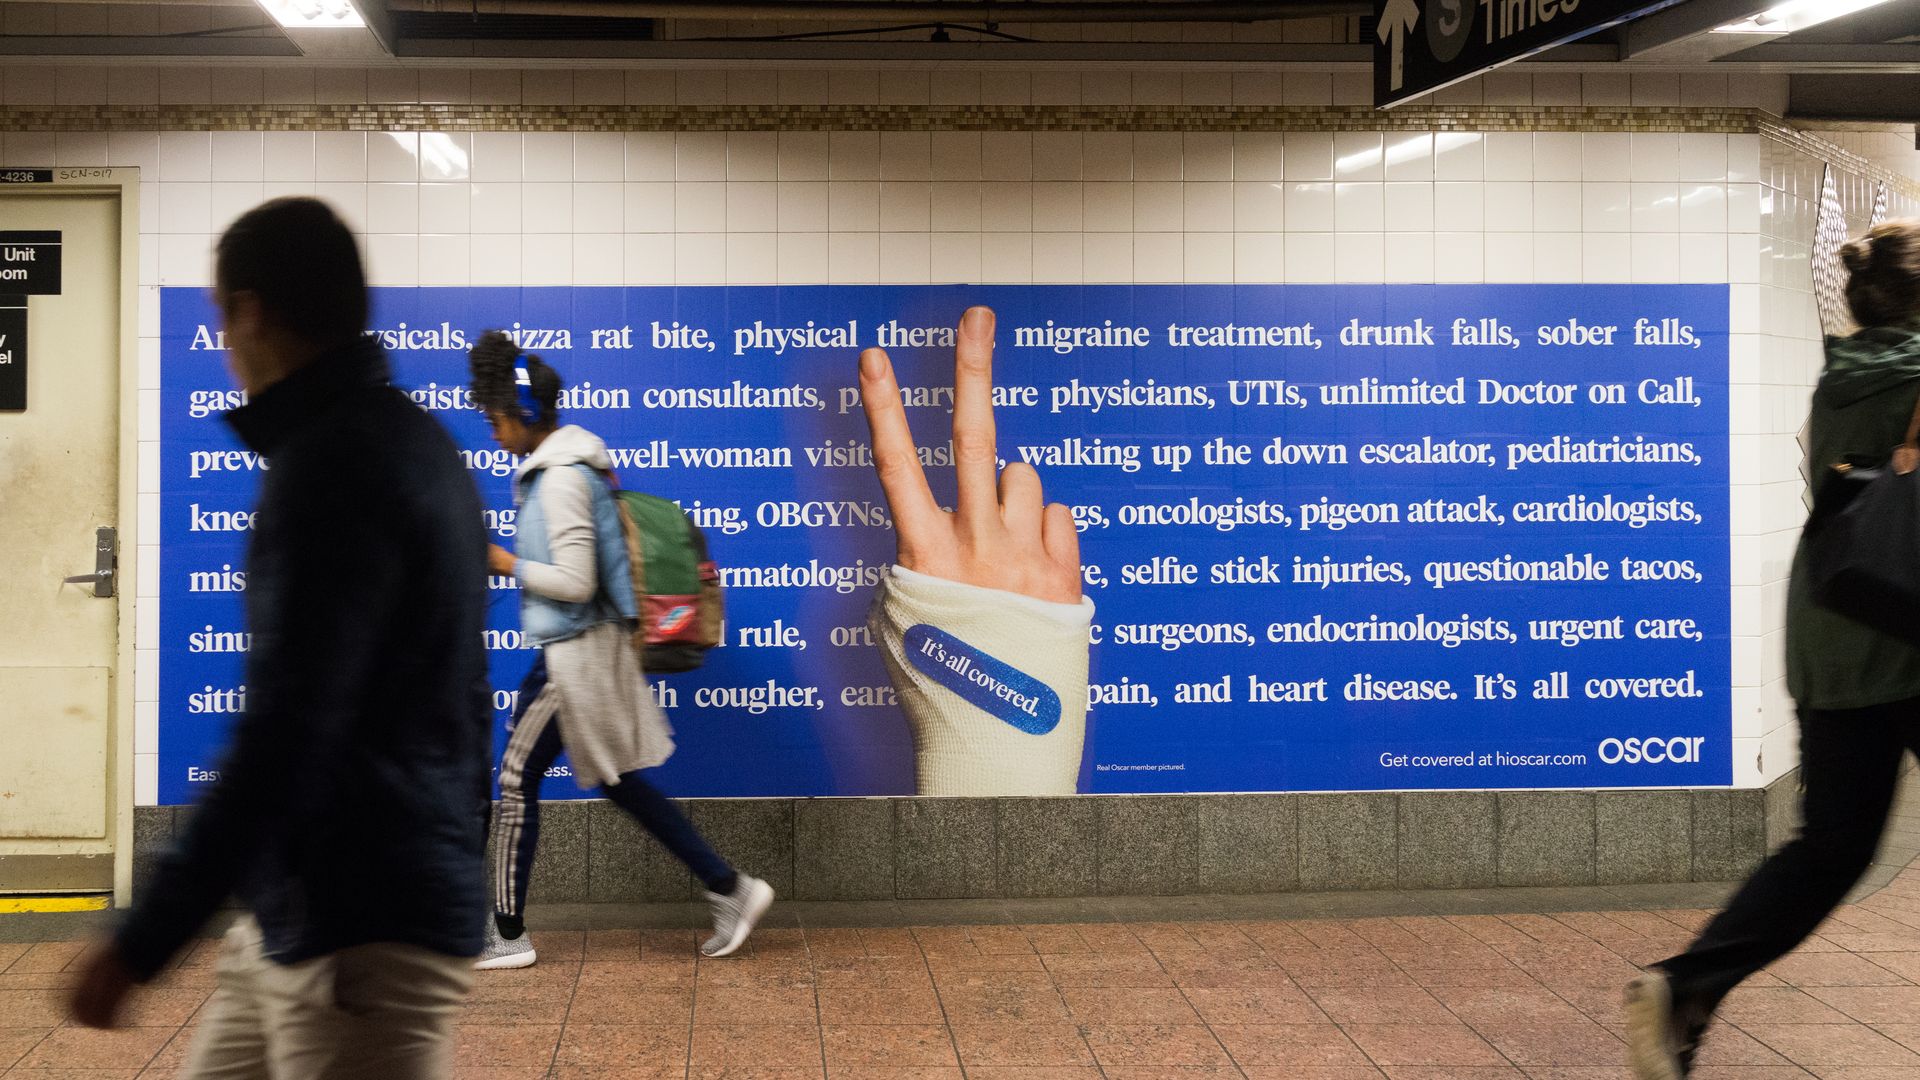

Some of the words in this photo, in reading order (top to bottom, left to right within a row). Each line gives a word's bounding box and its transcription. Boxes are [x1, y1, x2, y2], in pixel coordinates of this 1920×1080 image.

[60, 169, 112, 180] SCN-017
[4, 247, 36, 261] Unit
[591, 325, 634, 350] rat
[651, 321, 716, 353] bite,
[734, 320, 858, 355] physical
[1015, 320, 1150, 354] migraine
[1168, 323, 1322, 350] treatment,
[1340, 318, 1435, 347] drunk
[1451, 318, 1521, 350] falls,
[1538, 318, 1617, 346] sober
[1634, 318, 1702, 349] falls,
[643, 381, 826, 411] consultants,
[1051, 379, 1216, 414] physicians,
[1228, 381, 1308, 409] UTIs,
[1320, 377, 1466, 406] unlimited
[1478, 380, 1578, 405] Doctor
[1589, 384, 1627, 405] on
[1638, 377, 1702, 408] Call,
[608, 440, 793, 468] well-woman
[1017, 438, 1142, 474] walking
[1152, 446, 1192, 472] up
[1203, 438, 1252, 465] the
[1263, 437, 1349, 465] down
[1360, 436, 1496, 467] escalator,
[1507, 436, 1702, 470] pediatricians,
[757, 501, 893, 530] OBGYNs,
[1119, 497, 1292, 532] oncologists,
[1300, 497, 1401, 531] pigeon
[1407, 495, 1506, 526] attack,
[1513, 494, 1702, 529] cardiologists,
[1122, 557, 1198, 585] selfie
[1211, 556, 1281, 584] stick
[1293, 555, 1412, 590] injuries,
[1424, 553, 1609, 589] questionable
[1621, 556, 1703, 584] tacos,
[739, 620, 807, 650] rule,
[1115, 624, 1256, 651] surgeons,
[1267, 614, 1518, 648] endocrinologists,
[1529, 616, 1625, 647] urgent
[1635, 619, 1703, 642] care,
[695, 680, 824, 714] cougher,
[1086, 676, 1158, 711] pain,
[1175, 675, 1233, 704] and
[1249, 675, 1329, 703] heart
[1344, 674, 1458, 702] disease.
[1475, 673, 1517, 700] It's
[1533, 672, 1570, 700] all
[1585, 670, 1704, 699] covered.
[920, 637, 947, 663] It's
[945, 655, 972, 676] all
[968, 667, 1040, 718] covered.
[1158, 763, 1186, 772] pictured.
[1379, 752, 1409, 768] Get
[1411, 751, 1474, 767] covered
[1478, 753, 1493, 767] at
[1496, 750, 1587, 766] hioscar.com
[1597, 736, 1705, 764] oscar
